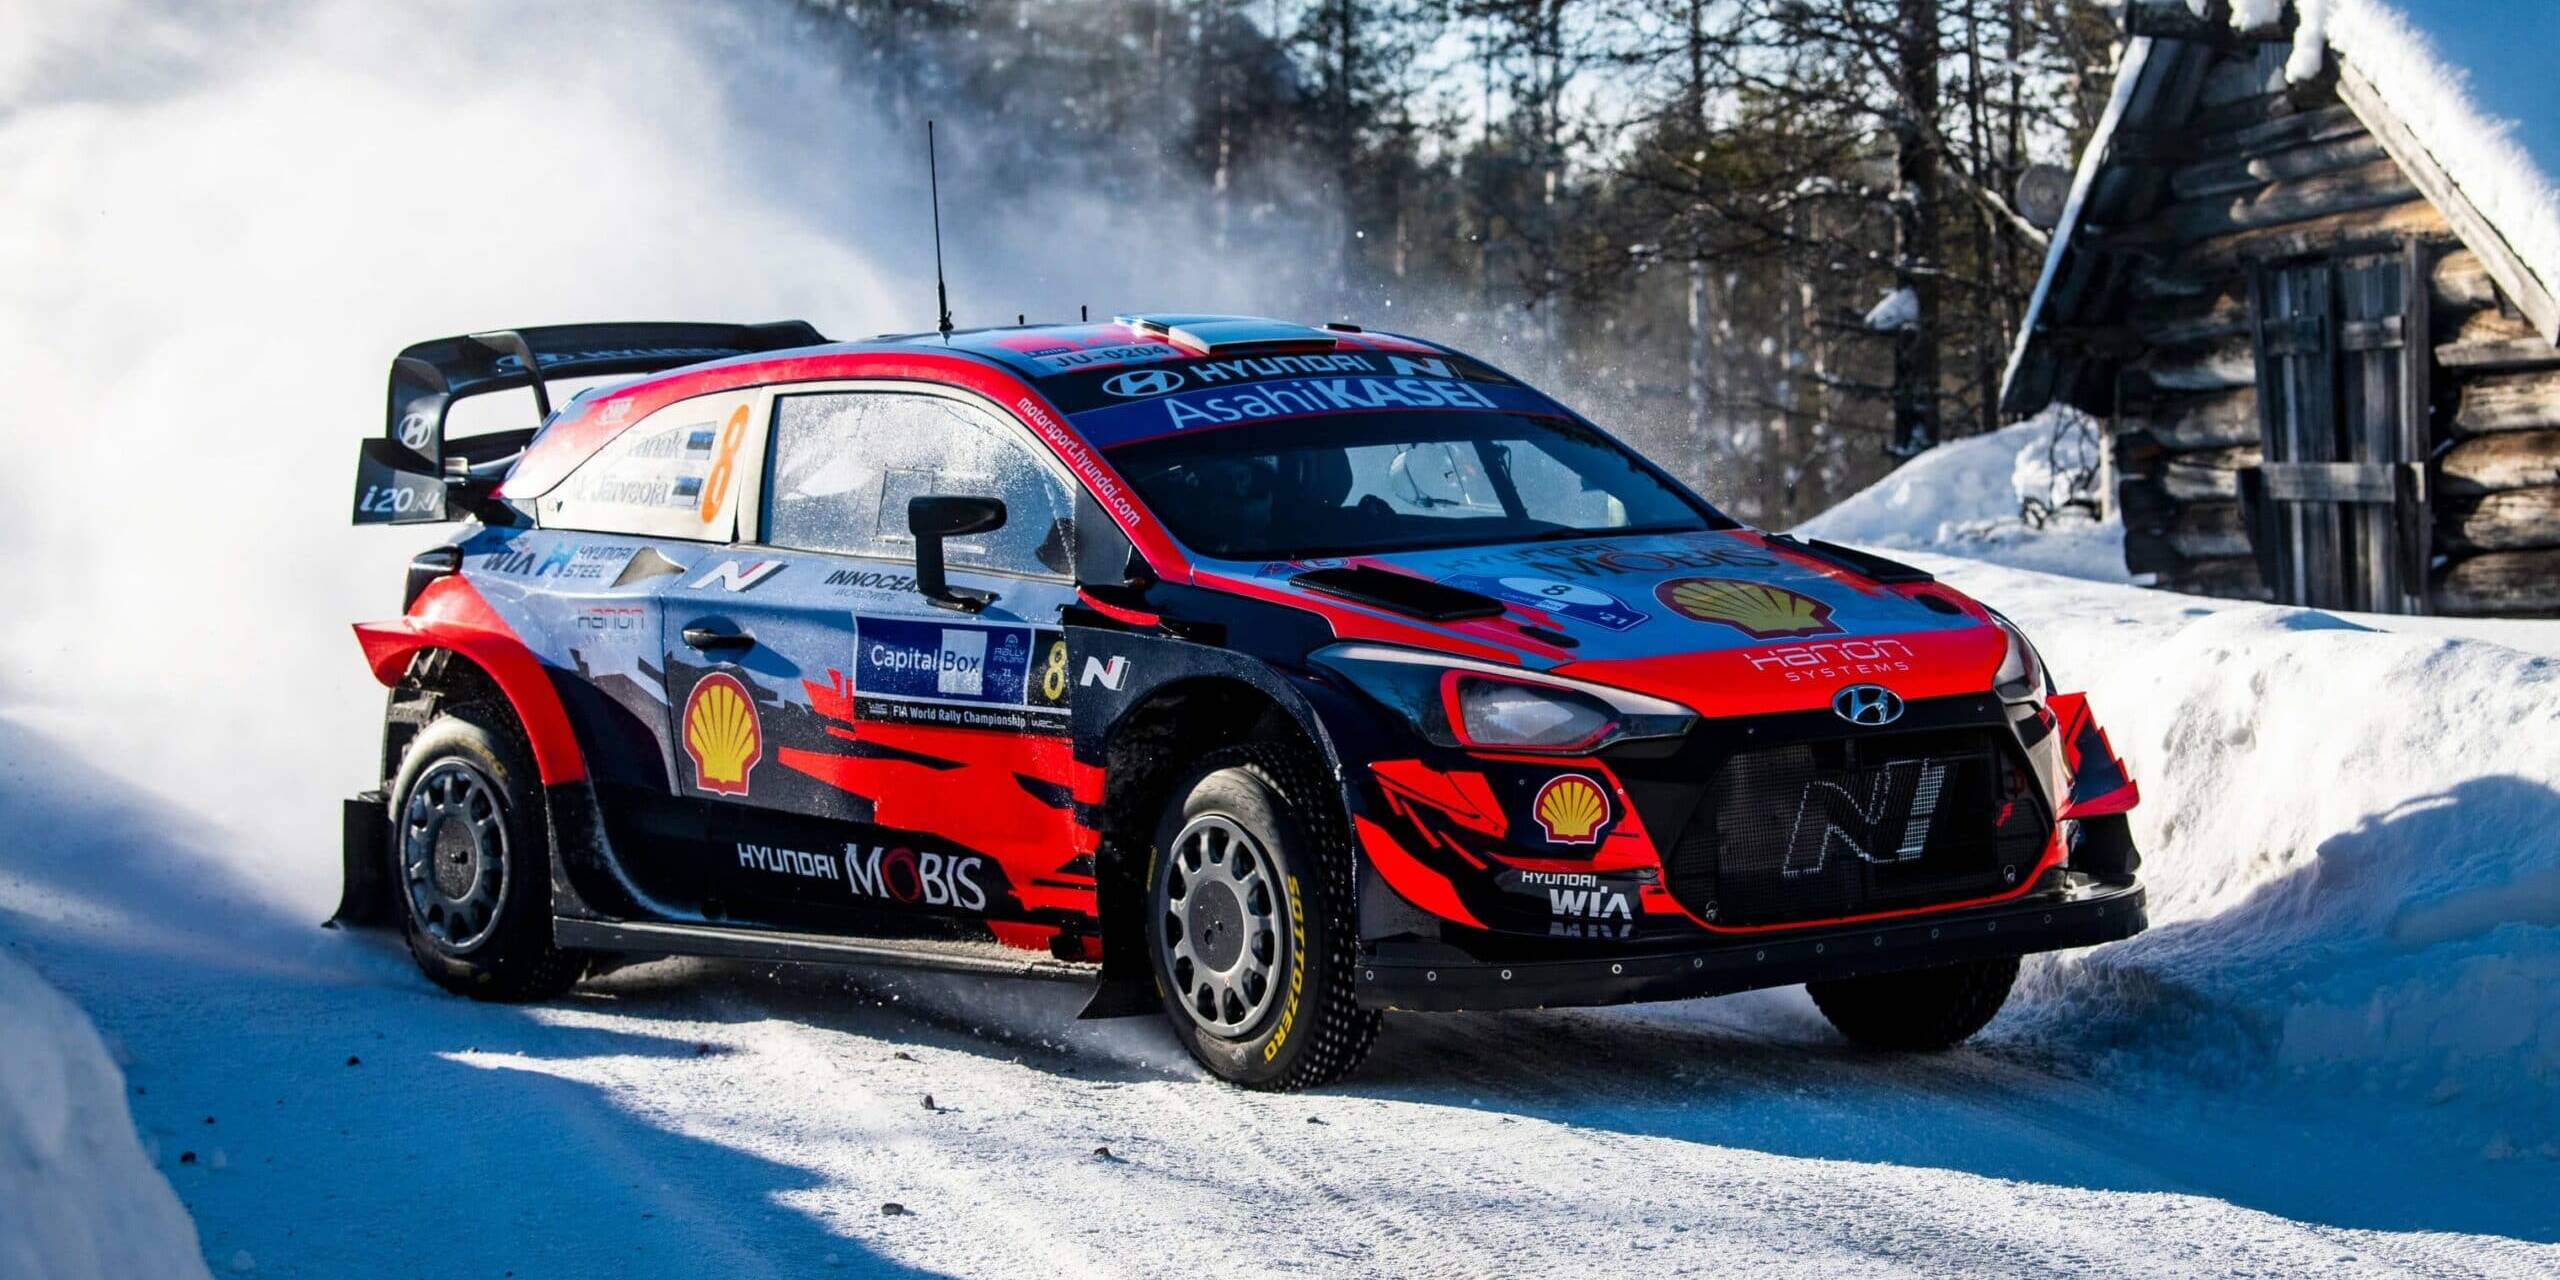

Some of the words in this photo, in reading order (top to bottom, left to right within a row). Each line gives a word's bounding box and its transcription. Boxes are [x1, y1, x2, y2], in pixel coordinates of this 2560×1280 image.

[1056, 345, 1170, 368] JU-0204
[1189, 355, 1377, 382] HYUNDAI
[1167, 378, 1498, 430] AsahiKASEI
[701, 403, 751, 525] 8
[1017, 397, 1141, 528] motorsport.hyundai.com
[825, 569, 917, 595] INNOCEA
[1540, 584, 1573, 597] 8
[1042, 640, 1068, 701] 8
[1785, 661, 1910, 682] SYSTEMS
[893, 705, 908, 718] FIA
[910, 707, 937, 720] World
[938, 709, 962, 725] Rally
[964, 711, 1027, 729] Championship
[737, 842, 840, 880] HYUNDAI
[845, 842, 988, 912] MOBIS
[1521, 870, 1597, 888] HYUNDAI
[1263, 872, 1305, 1063] SOTTOZERO
